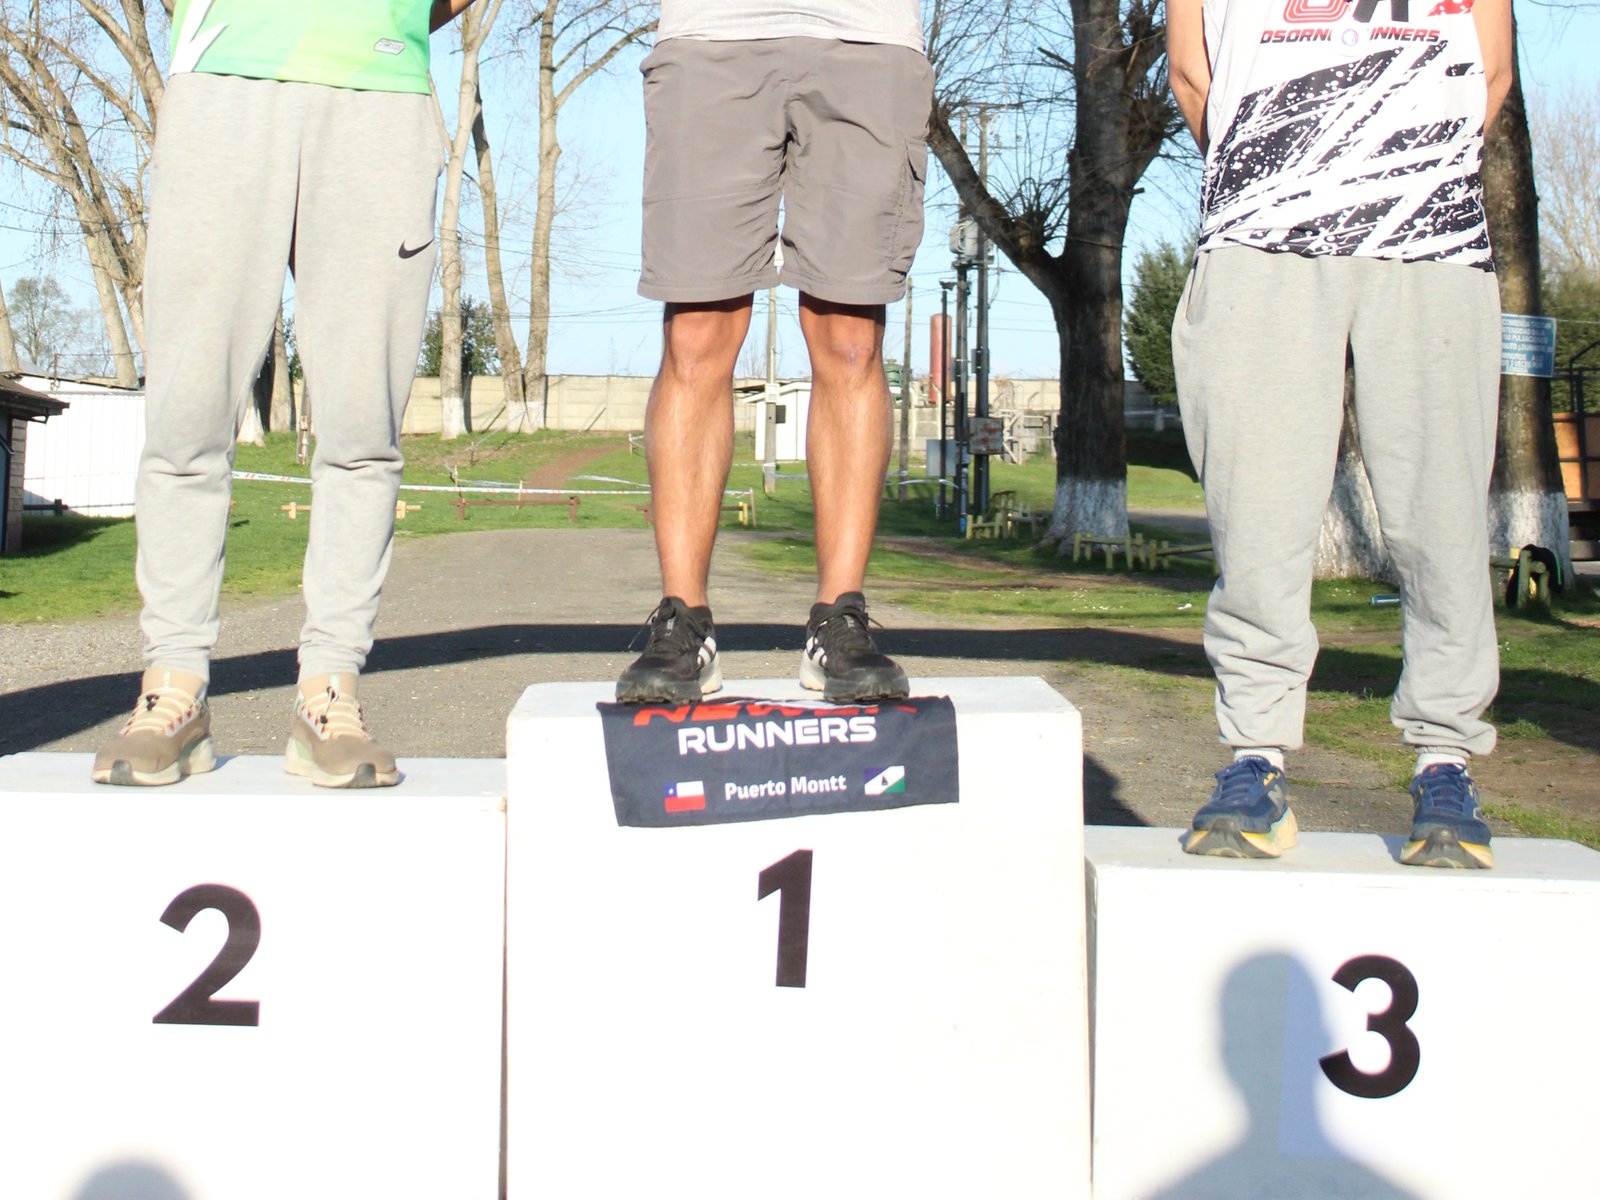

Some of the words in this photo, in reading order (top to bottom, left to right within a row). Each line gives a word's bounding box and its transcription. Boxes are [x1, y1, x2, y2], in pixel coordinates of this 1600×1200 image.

[1370, 26, 1440, 42] NNERS
[677, 716, 877, 755] RUNNERS
[724, 777, 787, 801] Puerto
[790, 774, 847, 795] Montt
[152, 883, 262, 1027] 2
[757, 848, 813, 988] 1
[1319, 954, 1420, 1099] 3
